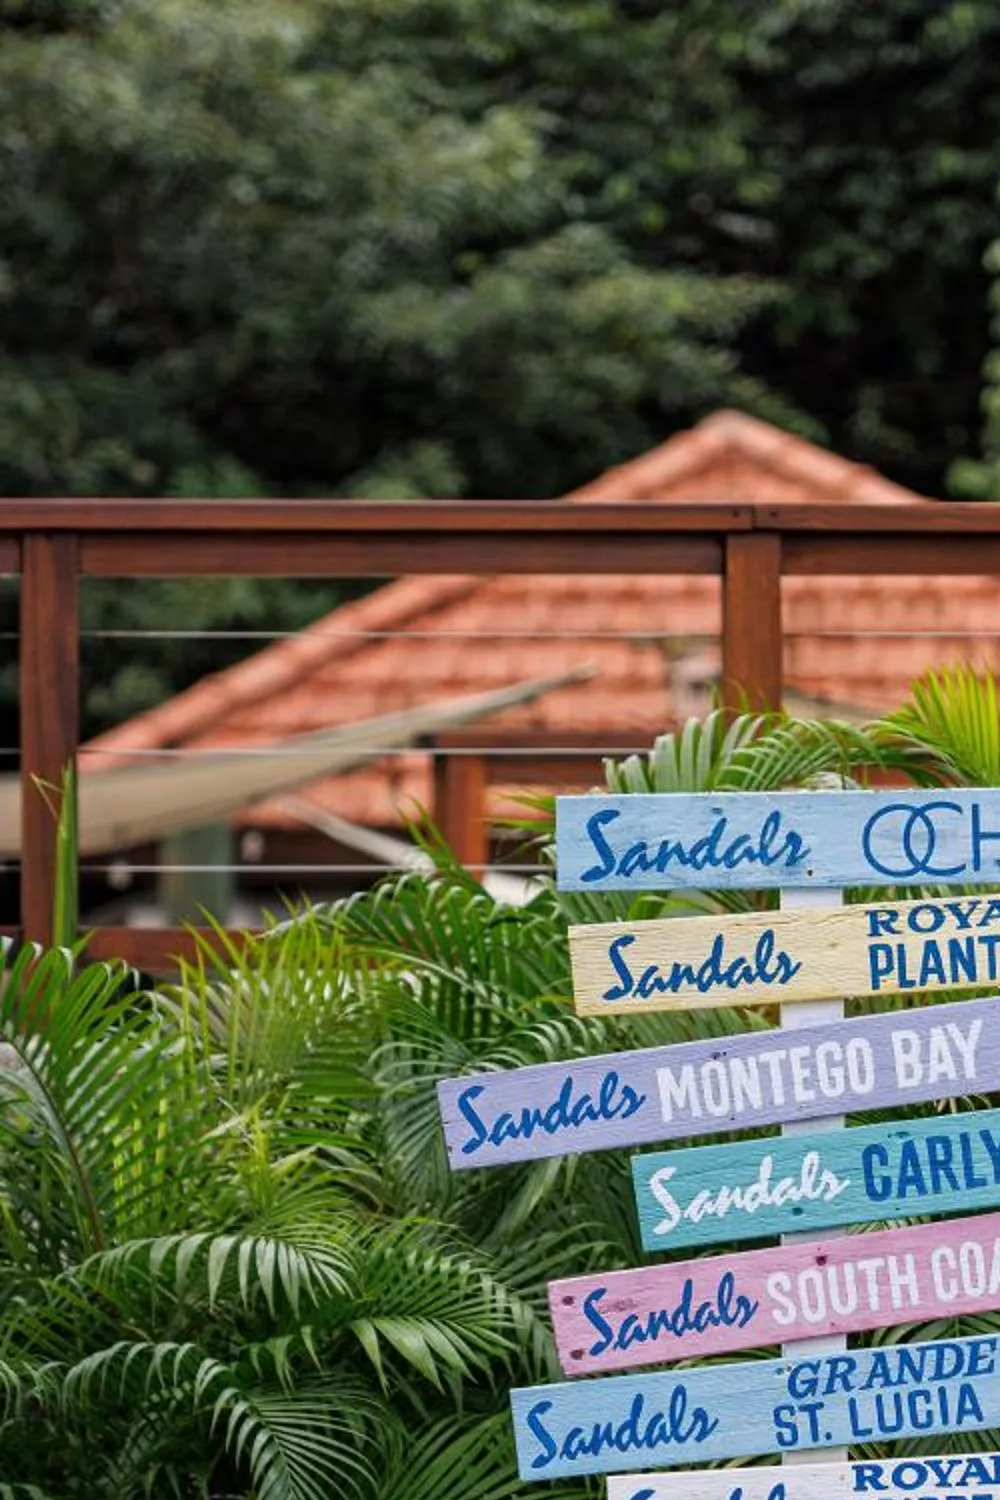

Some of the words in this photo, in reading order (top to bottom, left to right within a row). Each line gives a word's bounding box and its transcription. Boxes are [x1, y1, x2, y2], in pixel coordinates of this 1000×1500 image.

[580, 809, 810, 883] Sandals
[602, 930, 800, 1000] Sandals
[458, 1072, 645, 1154] Sandals
[657, 1037, 874, 1122] MONTEGO
[892, 1020, 983, 1088] BAY
[649, 1152, 850, 1234] Sandals
[582, 1273, 759, 1356] Sandals
[766, 1255, 919, 1326] SOUTH
[785, 1339, 997, 1399] GRANDE
[527, 1385, 718, 1469] Sandals
[773, 1401, 832, 1447] ST.
[849, 1383, 983, 1437] LUCIA
